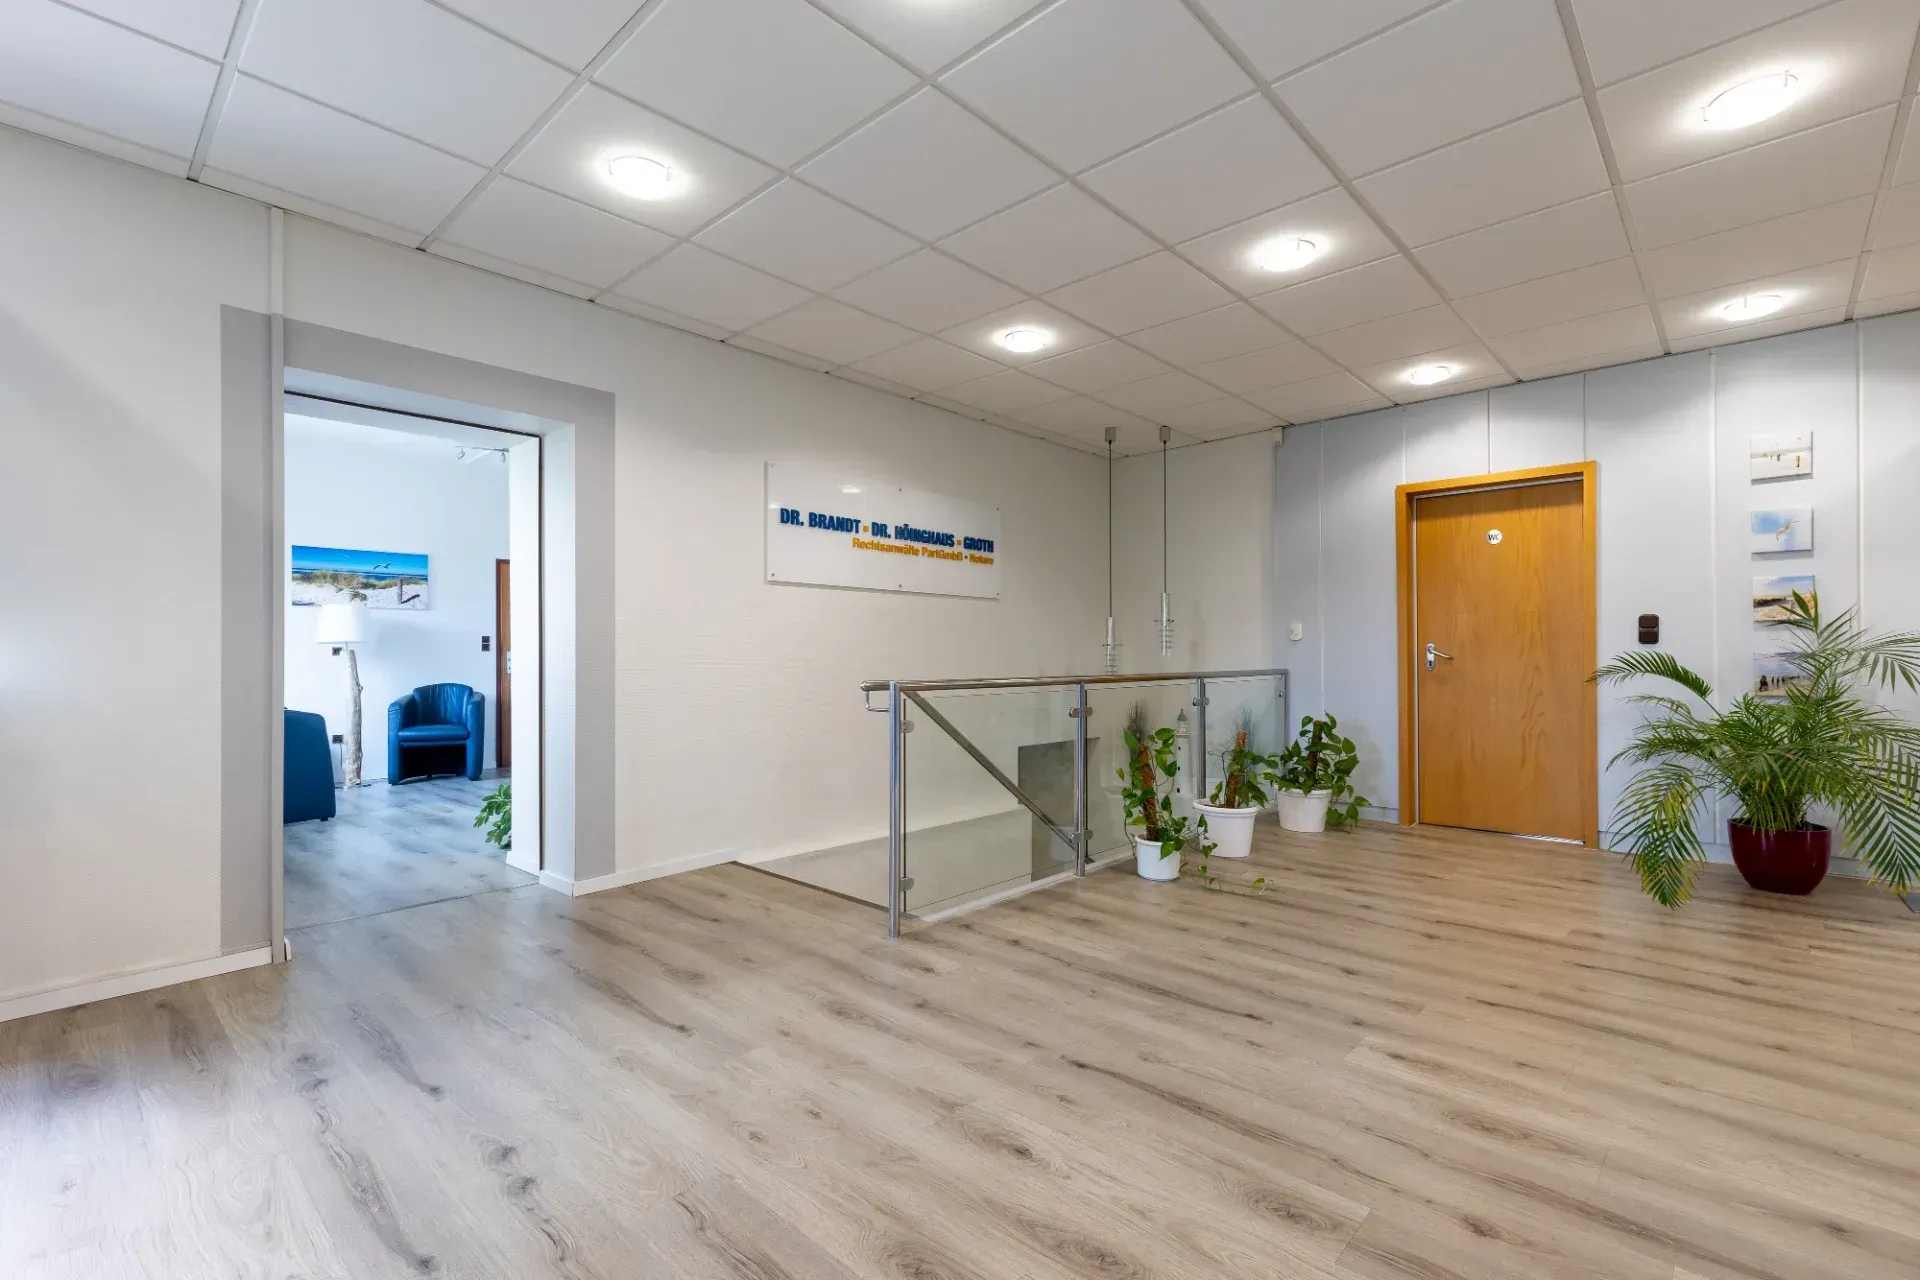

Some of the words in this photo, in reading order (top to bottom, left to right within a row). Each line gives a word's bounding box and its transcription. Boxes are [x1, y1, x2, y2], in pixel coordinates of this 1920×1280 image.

[780, 508, 804, 526] DR.
[808, 512, 861, 534] BRANDT
[871, 521, 891, 538] DR.
[894, 523, 955, 547] HÖINGHAUS
[963, 536, 994, 553] GROTH
[852, 537, 920, 556] Rechtsanwälte
[921, 546, 963, 561] PartGmbB
[969, 553, 994, 565] Notare
